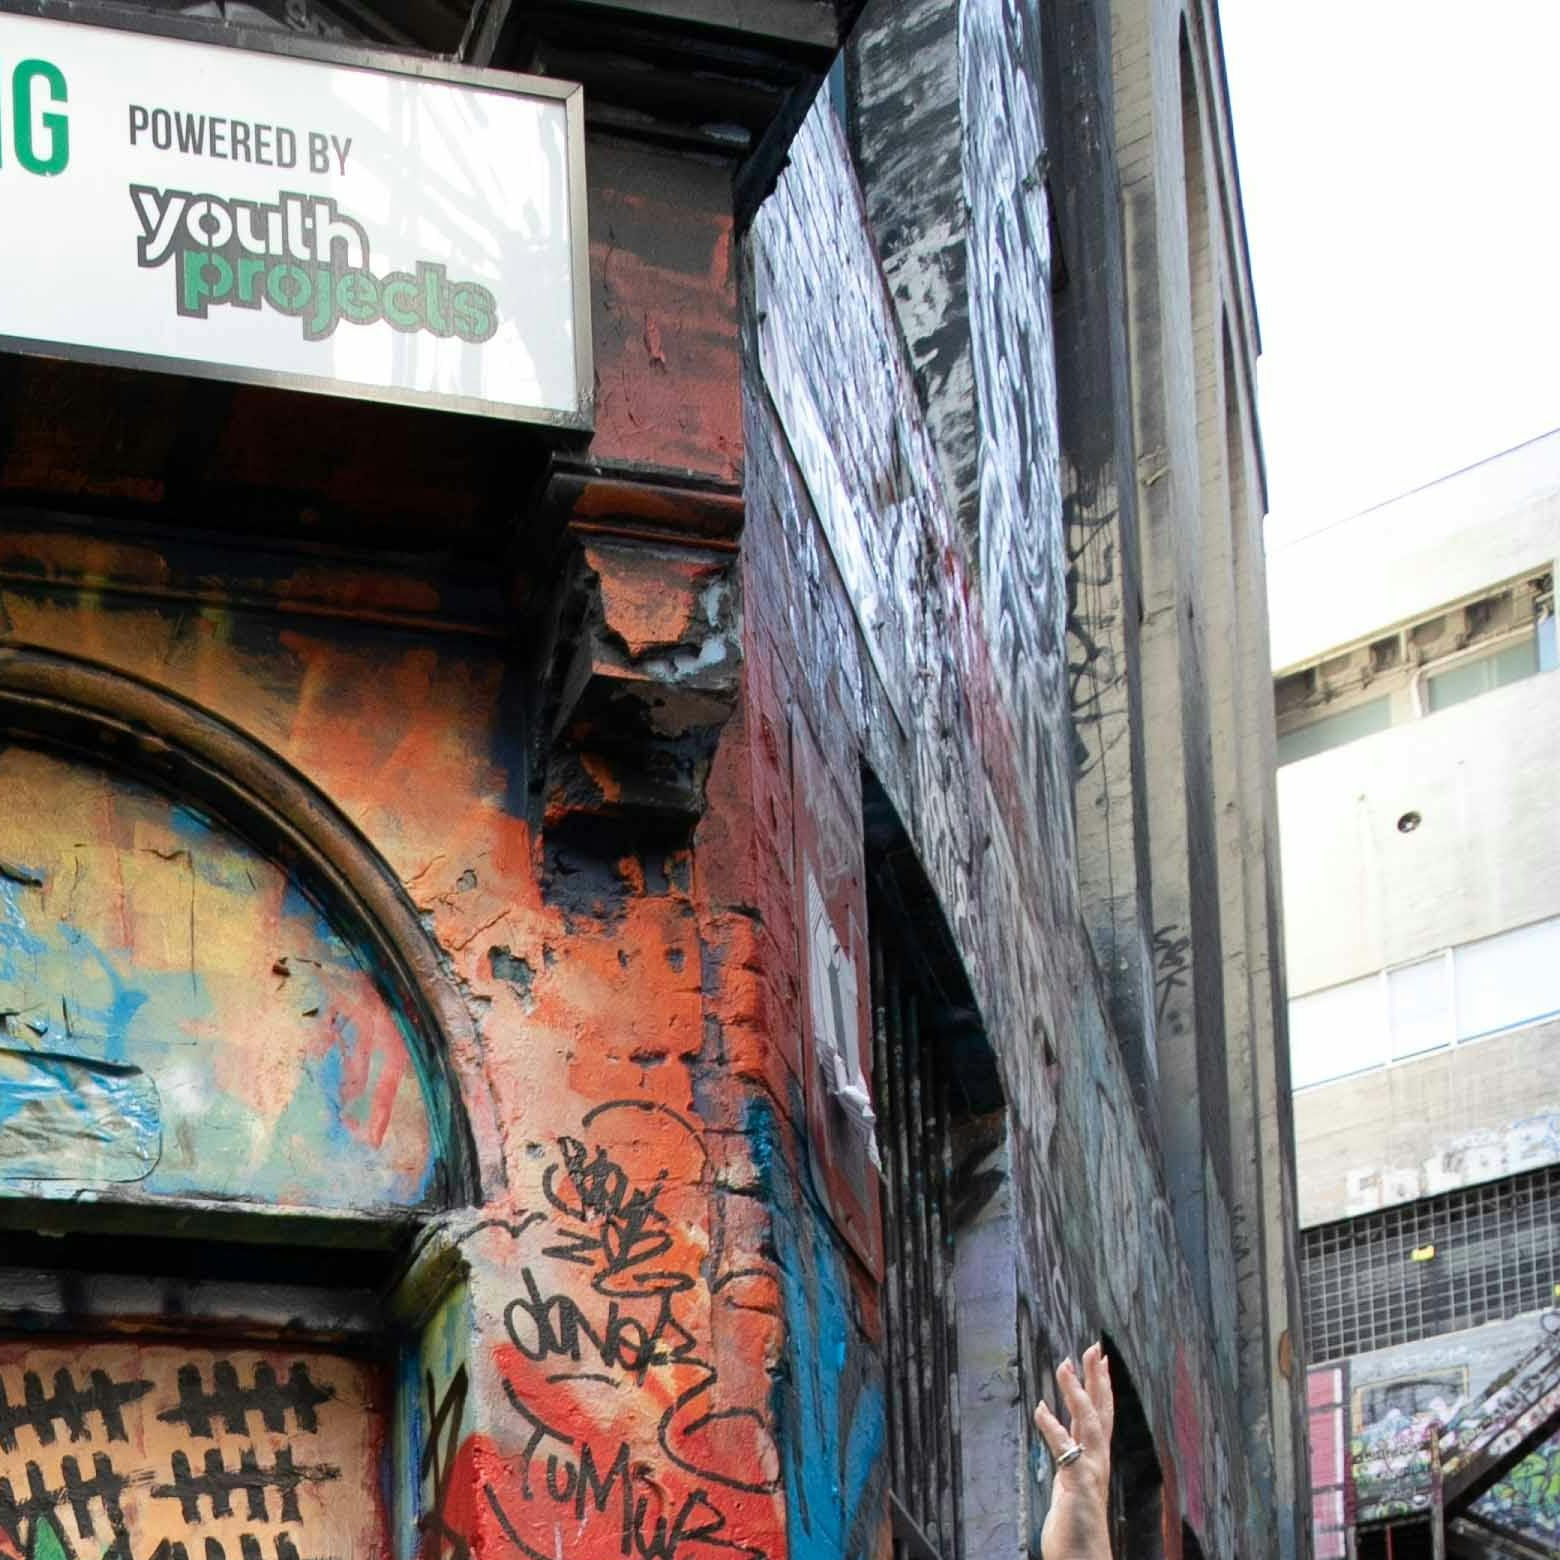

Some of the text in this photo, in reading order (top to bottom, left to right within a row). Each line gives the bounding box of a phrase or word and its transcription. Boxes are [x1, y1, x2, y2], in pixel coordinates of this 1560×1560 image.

[128, 104, 352, 176] POWERED BY
[129, 183, 370, 268] youth
[175, 249, 498, 344] projects
